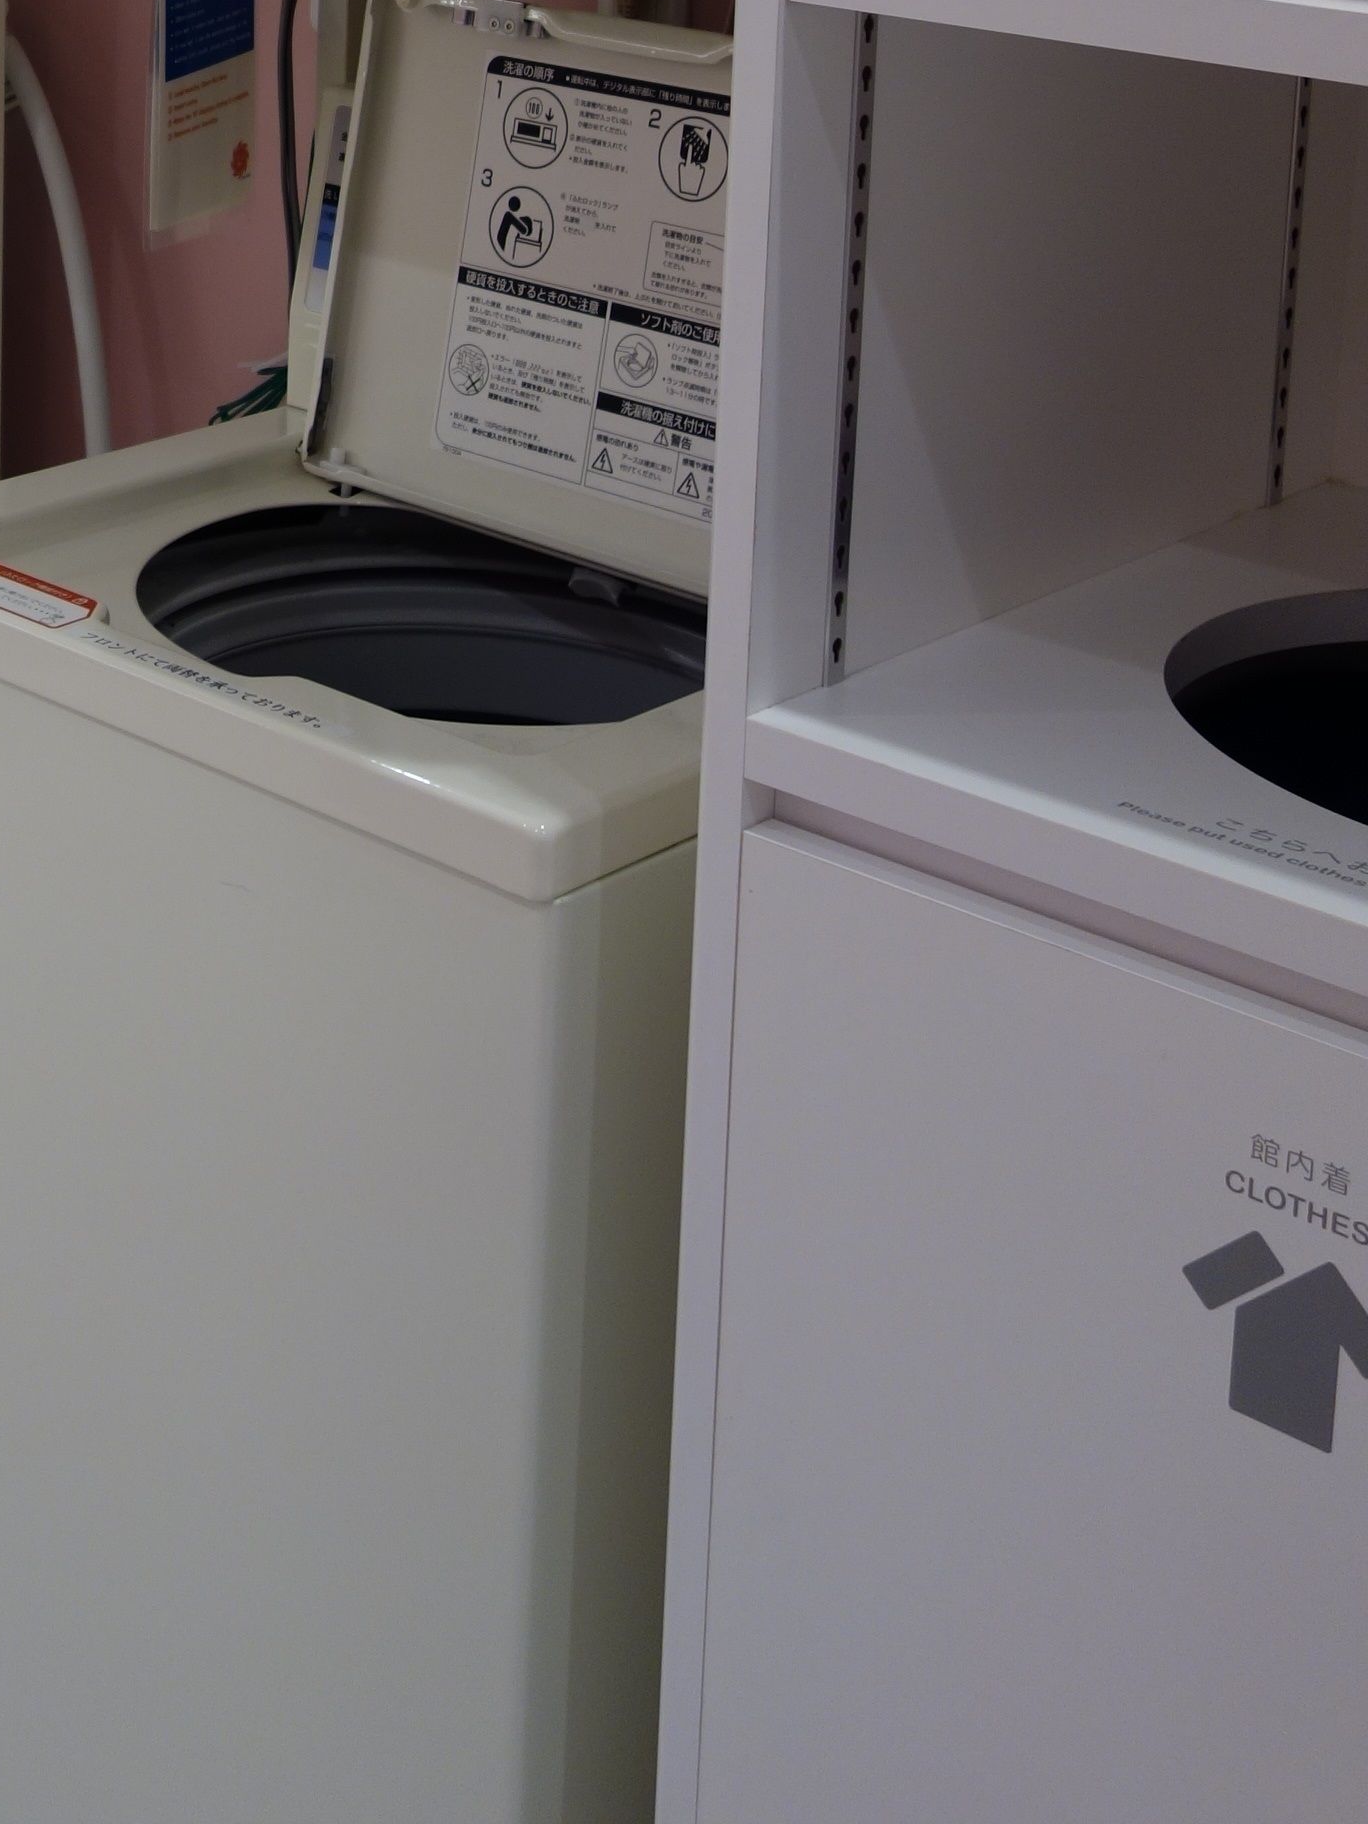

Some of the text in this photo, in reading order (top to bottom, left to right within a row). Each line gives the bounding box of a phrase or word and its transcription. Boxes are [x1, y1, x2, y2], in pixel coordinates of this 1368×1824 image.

[503, 61, 554, 81] 洗濯の順序
[497, 81, 502, 98] 1
[649, 109, 662, 128] 2
[481, 169, 493, 187] 3
[466, 270, 599, 314] 硬貨を投入するときのご注意
[671, 434, 692, 450] 警告
[1118, 801, 1368, 887] Please put used clothes
[1250, 1134, 1350, 1196] 館内着
[1225, 1170, 1368, 1246] CLOTHES
